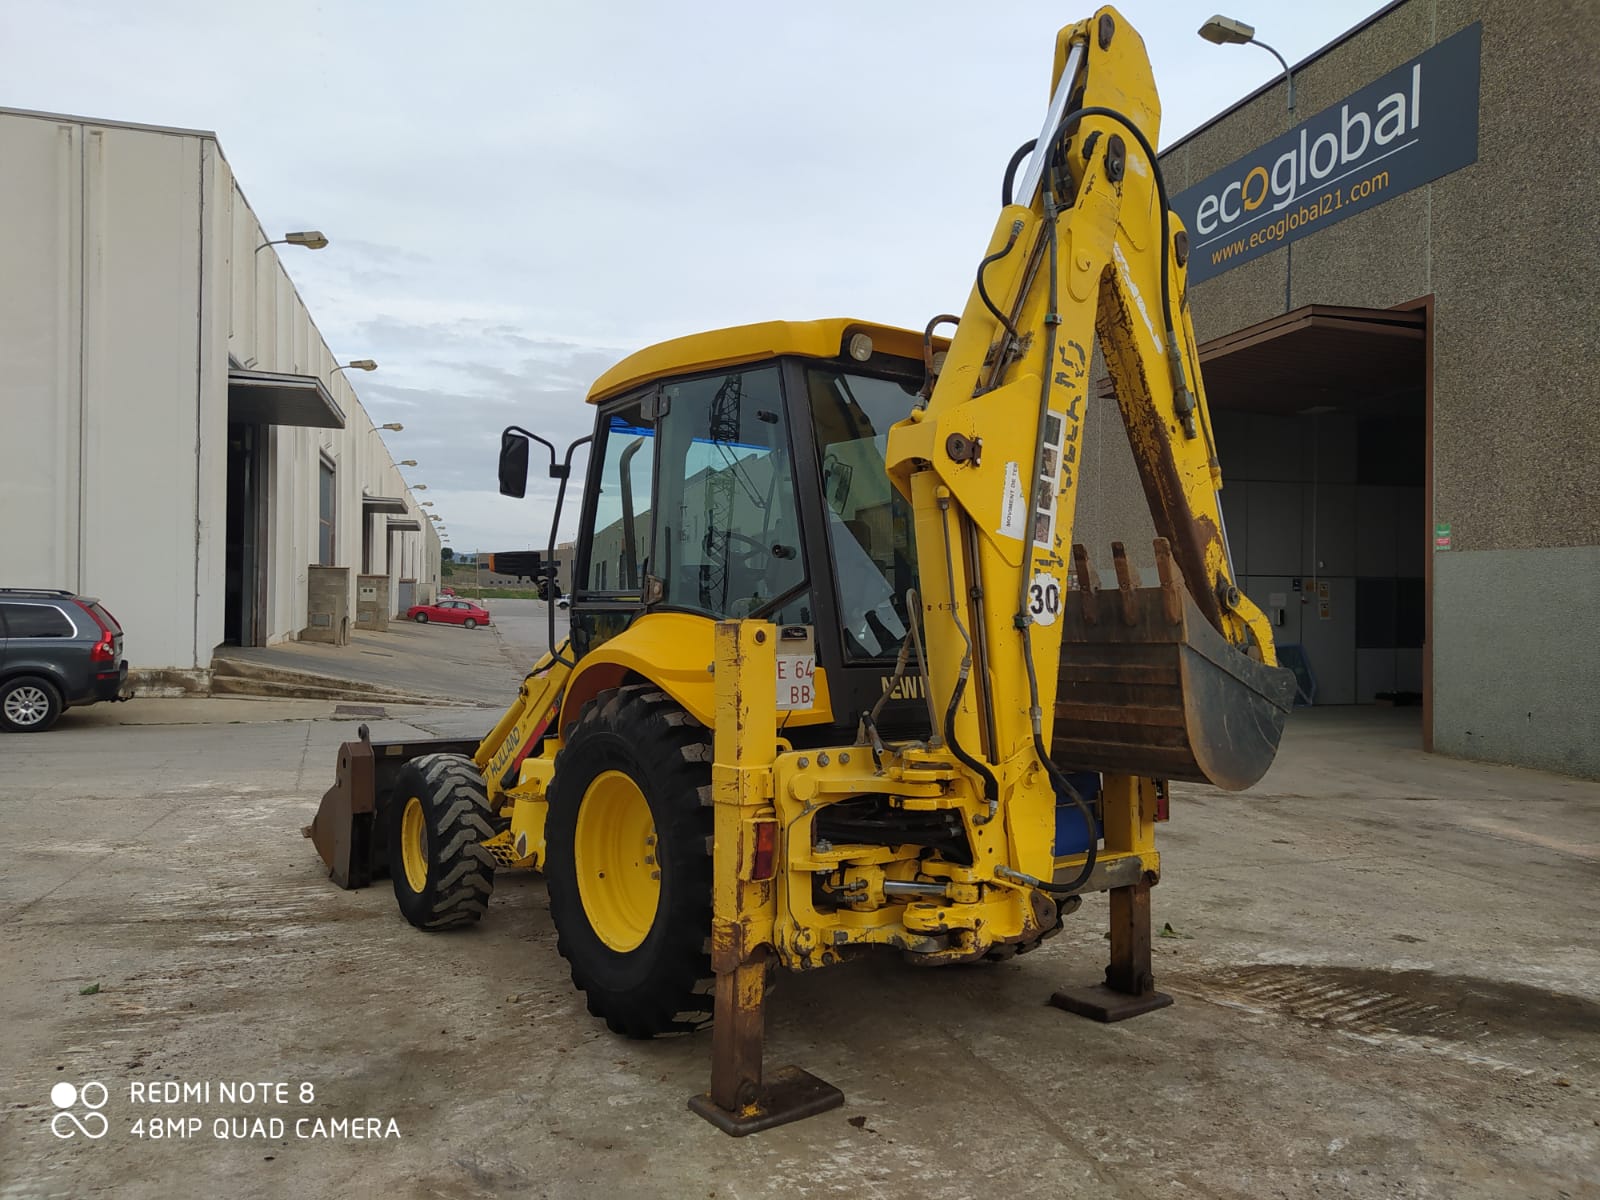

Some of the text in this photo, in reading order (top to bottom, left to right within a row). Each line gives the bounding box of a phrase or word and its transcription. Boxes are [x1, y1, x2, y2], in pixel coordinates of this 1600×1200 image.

[1196, 63, 1421, 235] ecoglobal
[1211, 170, 1390, 266] www.ecoglobal21.com
[1030, 584, 1059, 614] 30
[790, 685, 810, 704] BB
